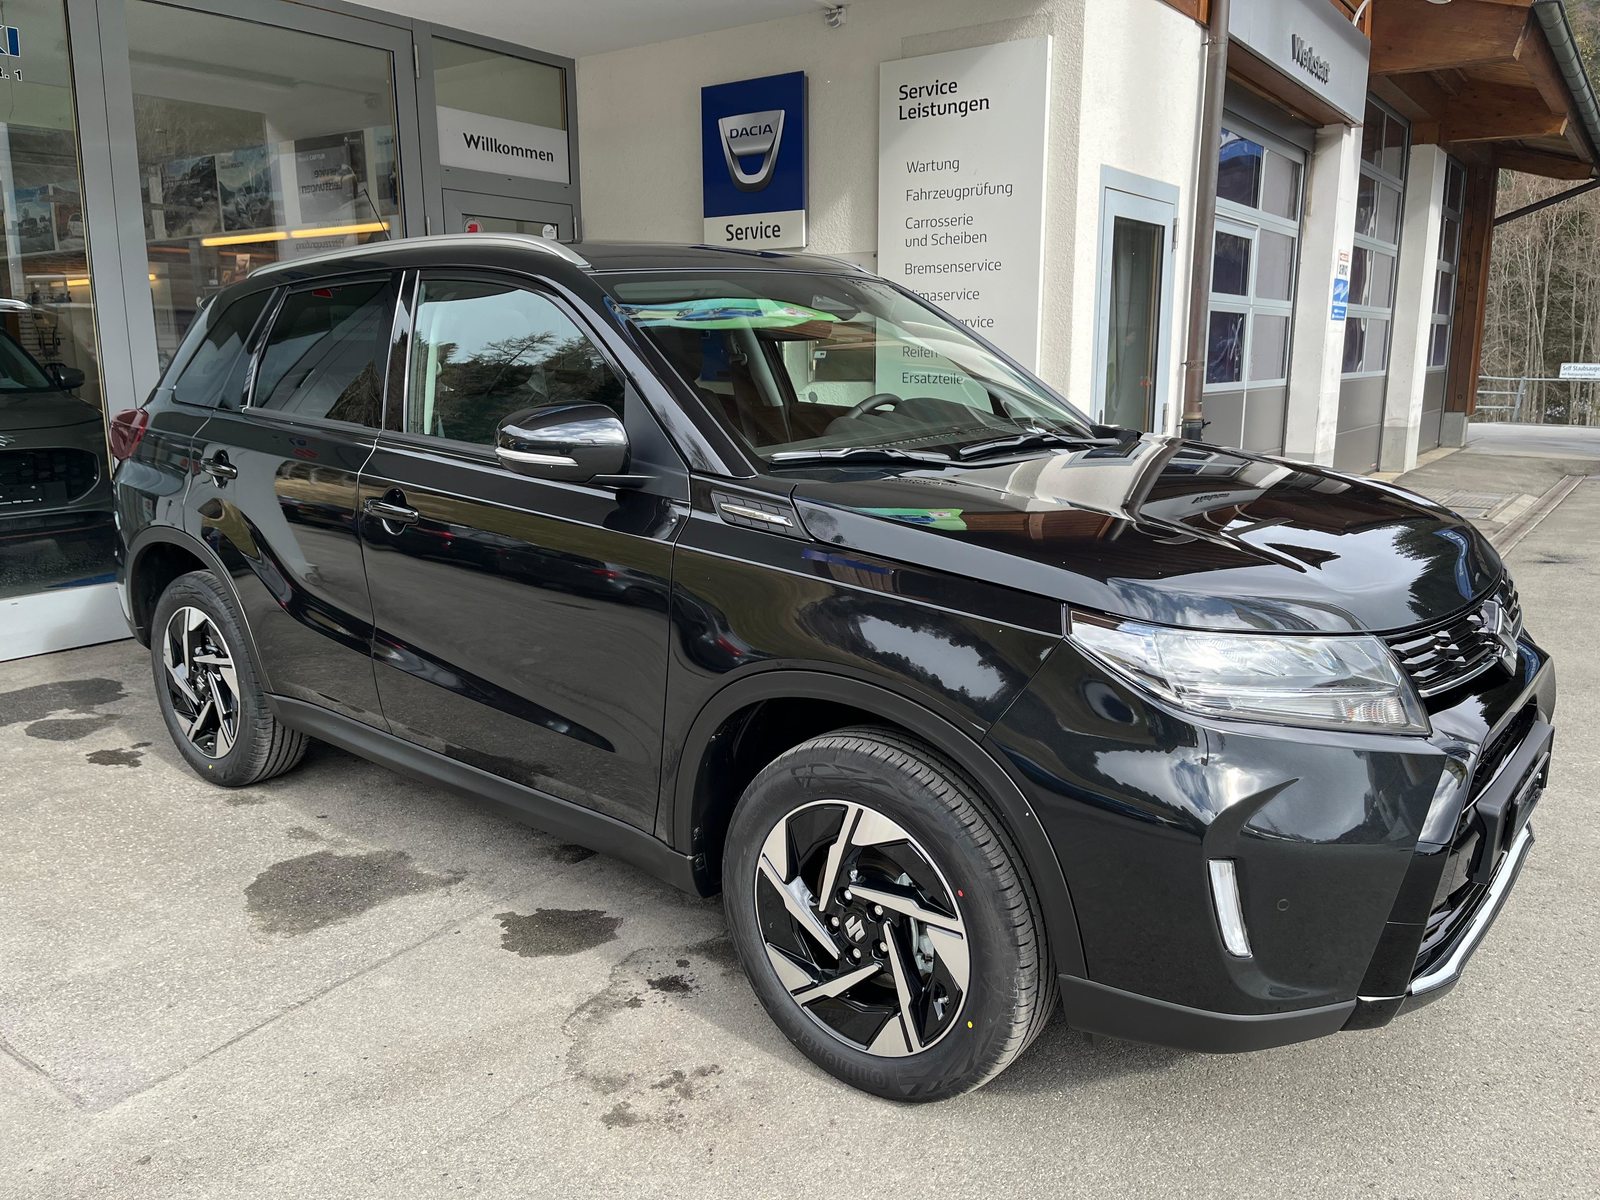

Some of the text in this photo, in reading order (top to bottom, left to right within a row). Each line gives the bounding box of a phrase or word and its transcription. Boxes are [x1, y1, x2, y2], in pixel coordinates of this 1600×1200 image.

[898, 79, 958, 101] Service
[898, 97, 990, 120] Leistungen
[729, 124, 773, 139] DACIA
[463, 132, 554, 162] Willkommen
[906, 159, 960, 174] Wartung
[905, 182, 1013, 201] Fahrzeugprüfung
[905, 213, 974, 229] Carrosserie
[725, 221, 781, 242] Service
[905, 231, 987, 248] und Scheiben
[904, 258, 1002, 275] Bremsenservice
[902, 372, 963, 385] Ersatzteile
